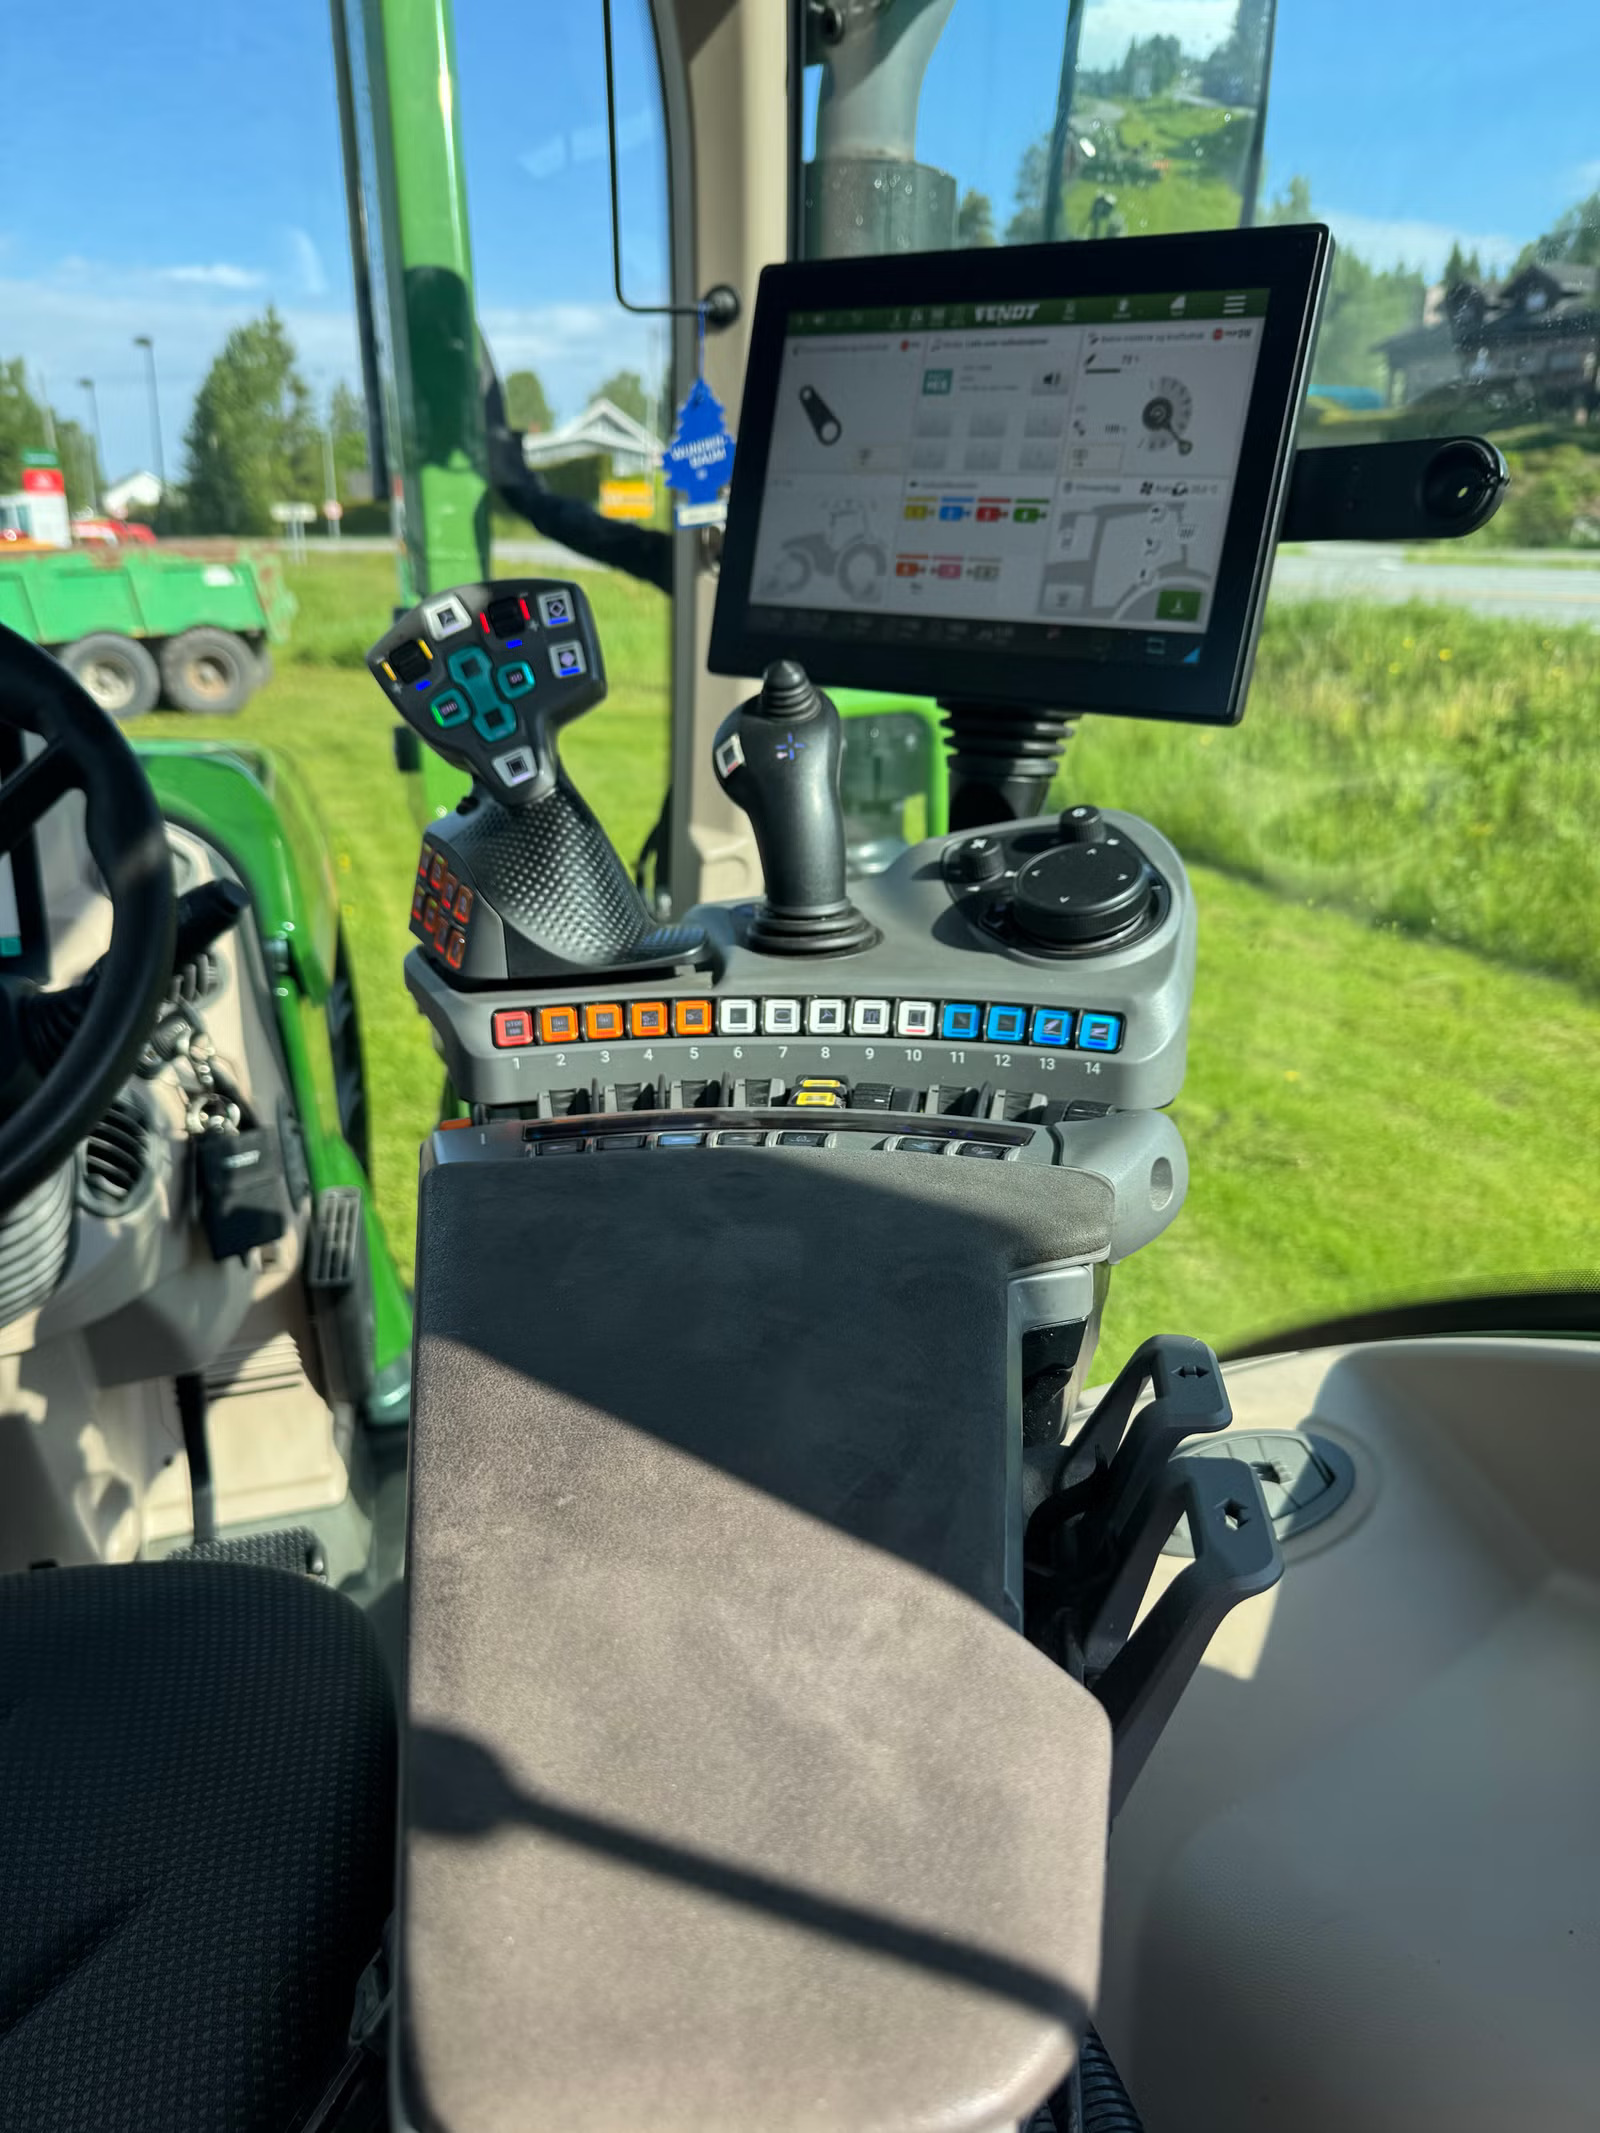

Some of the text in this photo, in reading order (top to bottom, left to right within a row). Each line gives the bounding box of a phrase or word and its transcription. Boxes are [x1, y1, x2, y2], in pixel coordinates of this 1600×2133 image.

[513, 1046, 1100, 1074] 1 2 3 4 5 6 7 8 9 10 11 12 13 14
